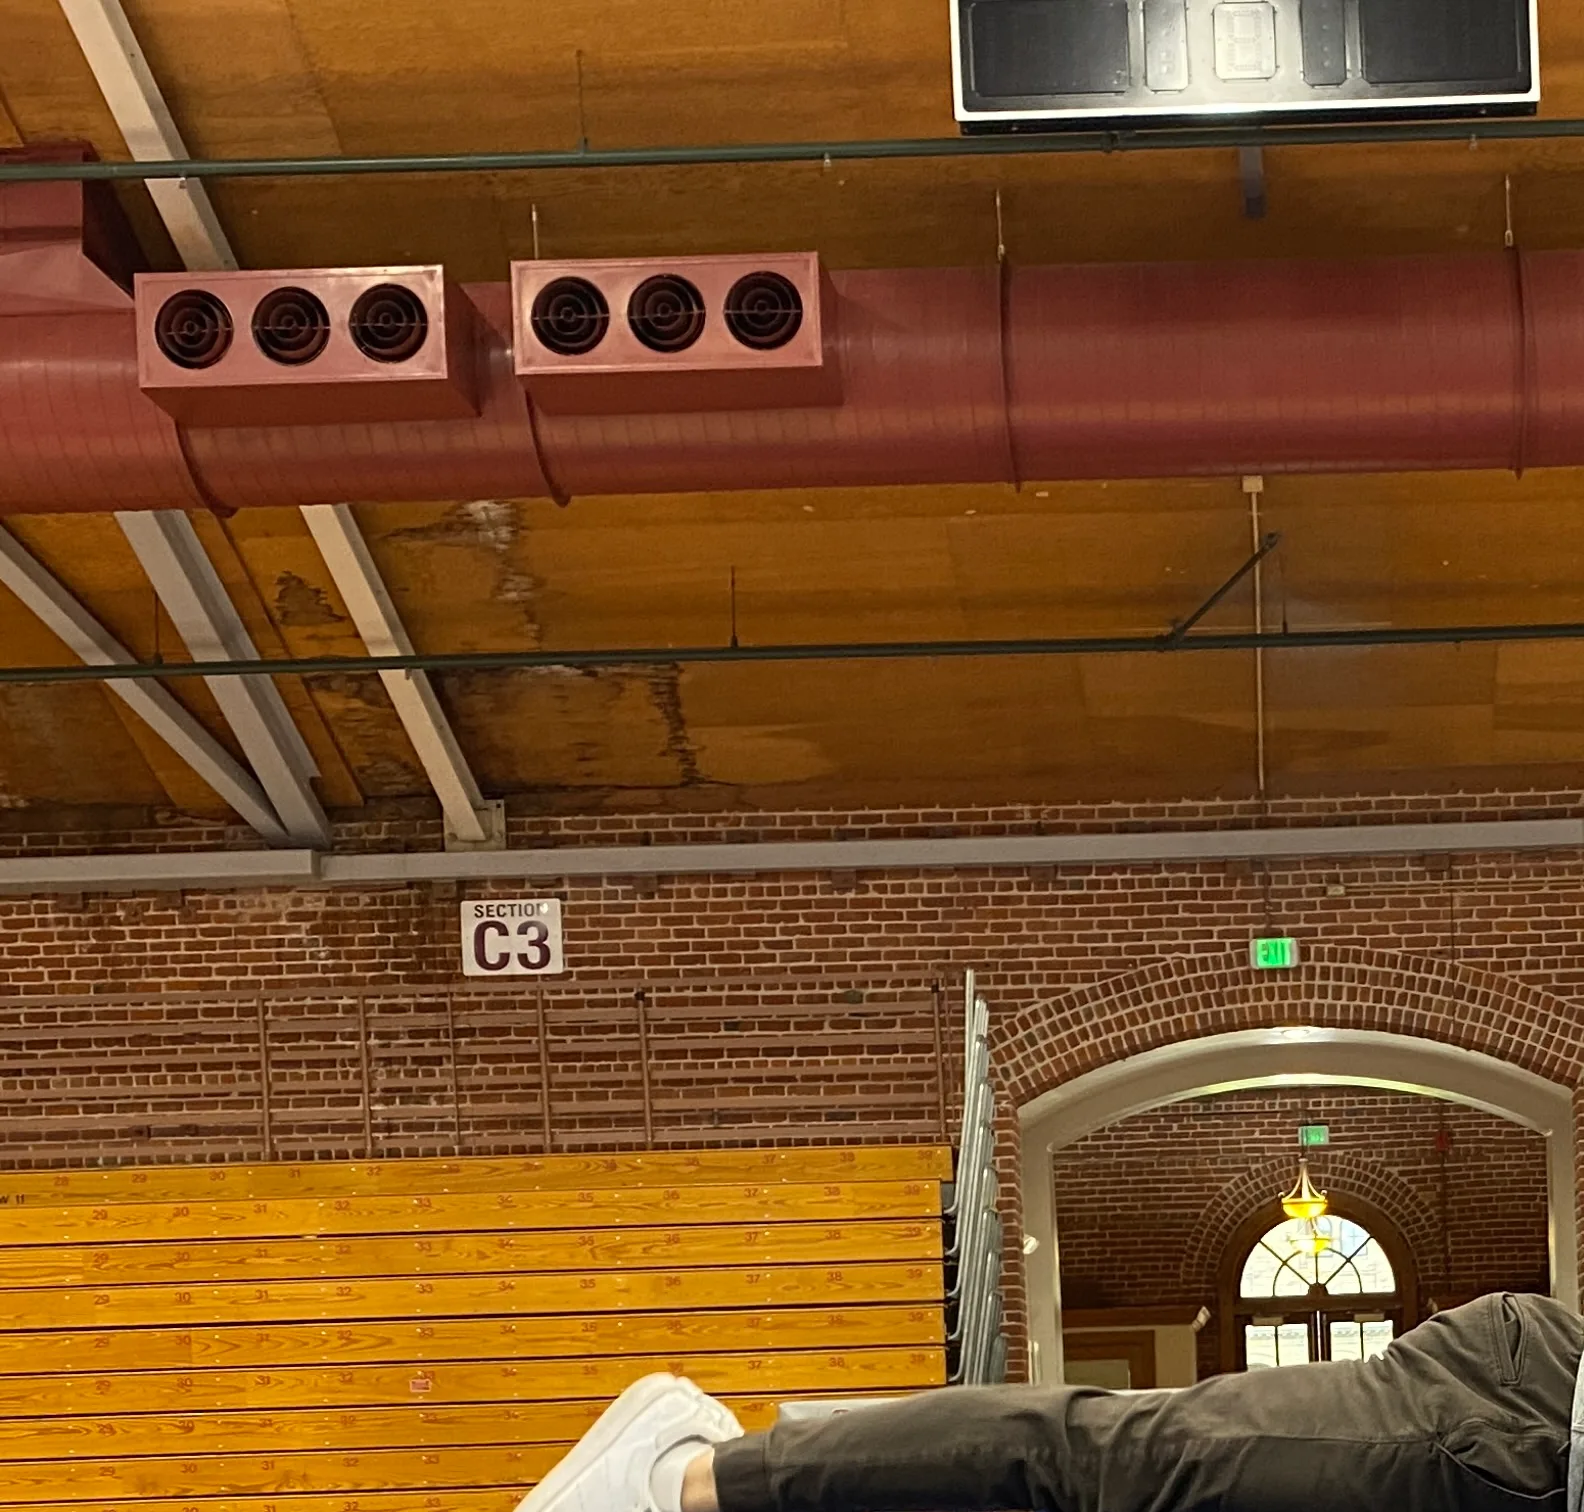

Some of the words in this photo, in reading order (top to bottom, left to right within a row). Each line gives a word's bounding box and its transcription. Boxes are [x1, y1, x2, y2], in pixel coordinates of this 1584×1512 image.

[473, 920, 551, 971] C3
[1260, 941, 1290, 966] EXIT
[762, 1154, 777, 1165] 37
[366, 1166, 382, 1176] 32
[744, 1188, 759, 1198] 37
[174, 1206, 190, 1217] 30
[254, 1203, 268, 1214] 31
[93, 1209, 108, 1220] 29
[744, 1232, 760, 1242] 37
[746, 1274, 761, 1284] 37
[827, 1271, 843, 1282] 38
[907, 1268, 922, 1279] 39
[418, 1283, 433, 1294] 33
[580, 1278, 596, 1289] 35
[337, 1286, 352, 1296] 32
[95, 1294, 110, 1305] 29
[175, 1292, 191, 1303] 30
[909, 1311, 924, 1322] 39
[746, 1317, 762, 1328] 37
[176, 1335, 191, 1346] 30
[747, 1359, 763, 1370] 37
[829, 1357, 845, 1368] 38
[910, 1354, 926, 1364] 39
[261, 1460, 276, 1471] 31
[343, 1457, 359, 1468] 32
[182, 1463, 197, 1474] 30
